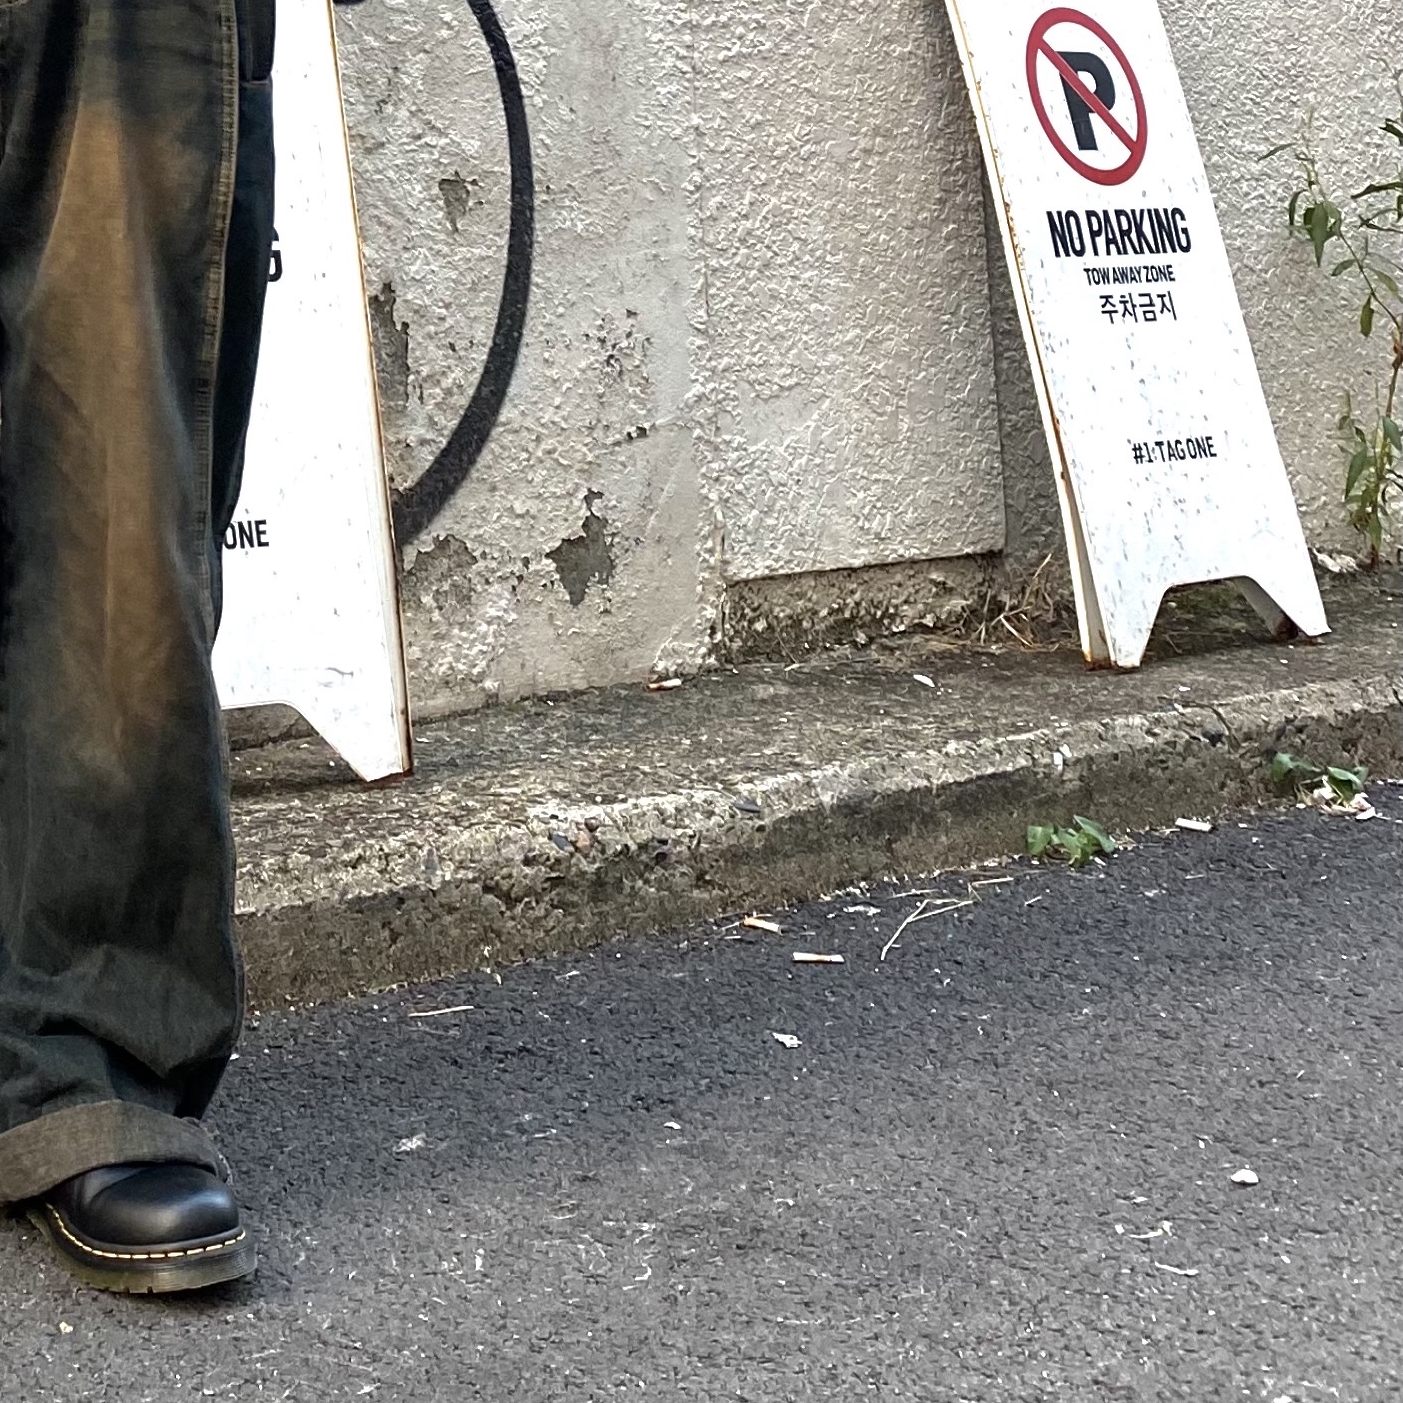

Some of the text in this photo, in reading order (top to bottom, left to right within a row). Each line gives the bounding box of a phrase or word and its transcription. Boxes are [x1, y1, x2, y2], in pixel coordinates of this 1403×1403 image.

[1045, 207, 1192, 258] NO PARKING
[1083, 264, 1176, 286] TOW AWAY ZONE
[1099, 290, 1177, 324] 주차금지
